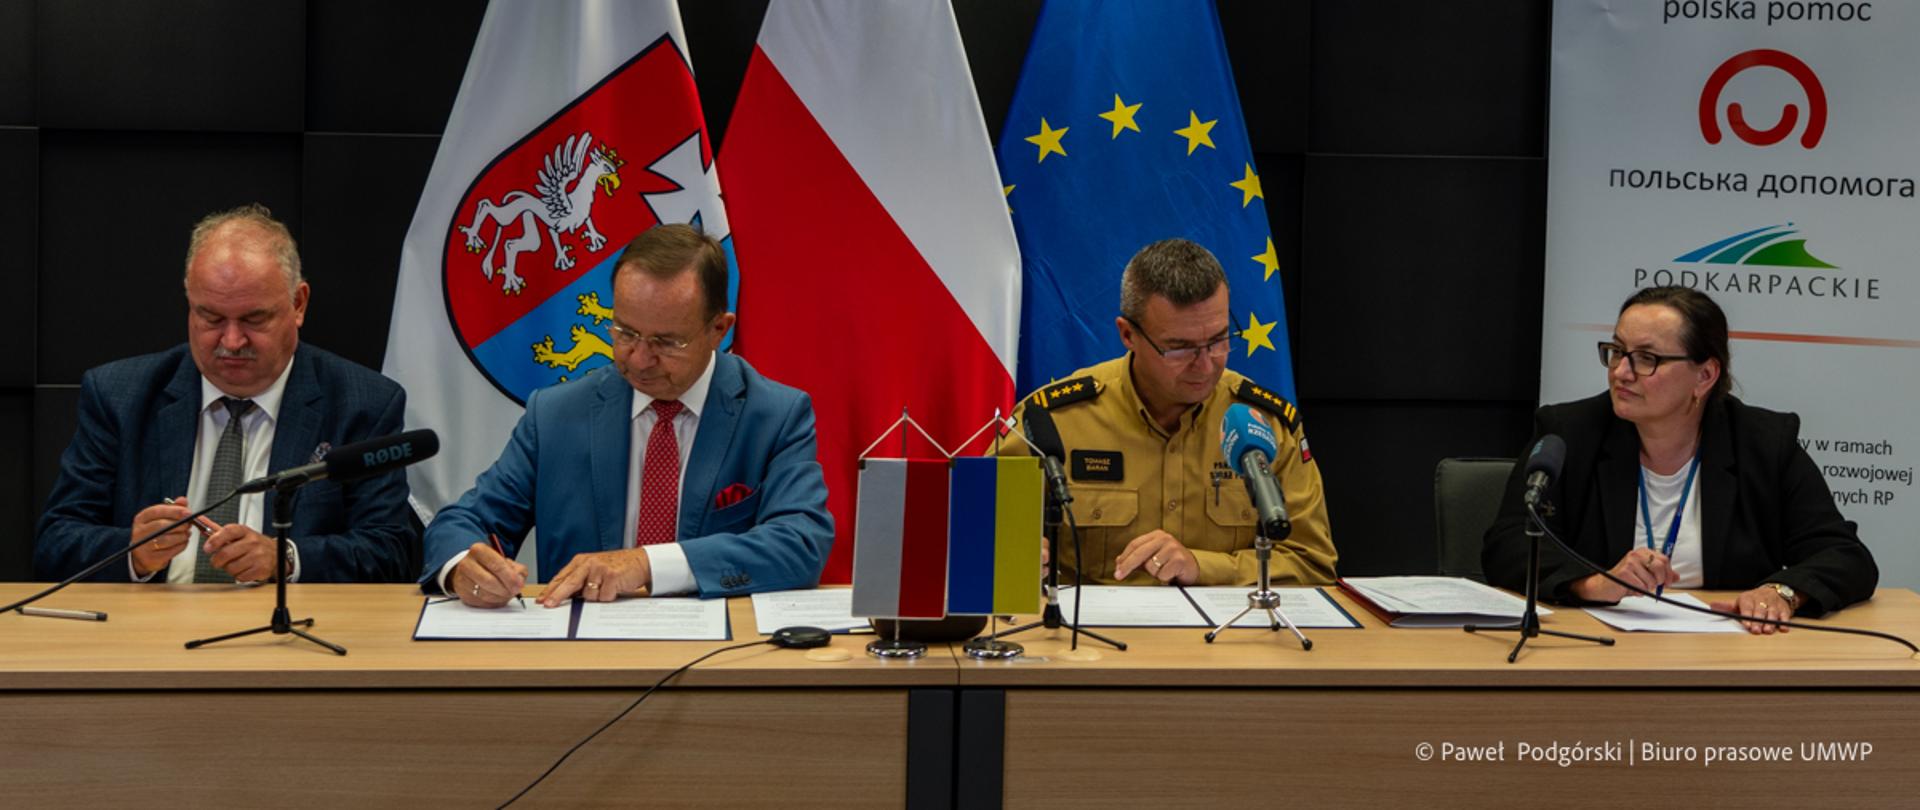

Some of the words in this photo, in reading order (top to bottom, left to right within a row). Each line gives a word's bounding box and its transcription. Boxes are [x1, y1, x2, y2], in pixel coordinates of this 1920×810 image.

[1664, 0, 1756, 24] polska
[1767, 1, 1872, 26] pomoc
[1609, 168, 1748, 193] польська
[1757, 173, 1915, 198] допомога
[1634, 268, 1880, 300] PODKARPACKIE
[1815, 439, 1829, 451] w
[1834, 440, 1893, 456] ramach
[1823, 464, 1913, 486] rozwojowej
[1874, 490, 1894, 506] RP
